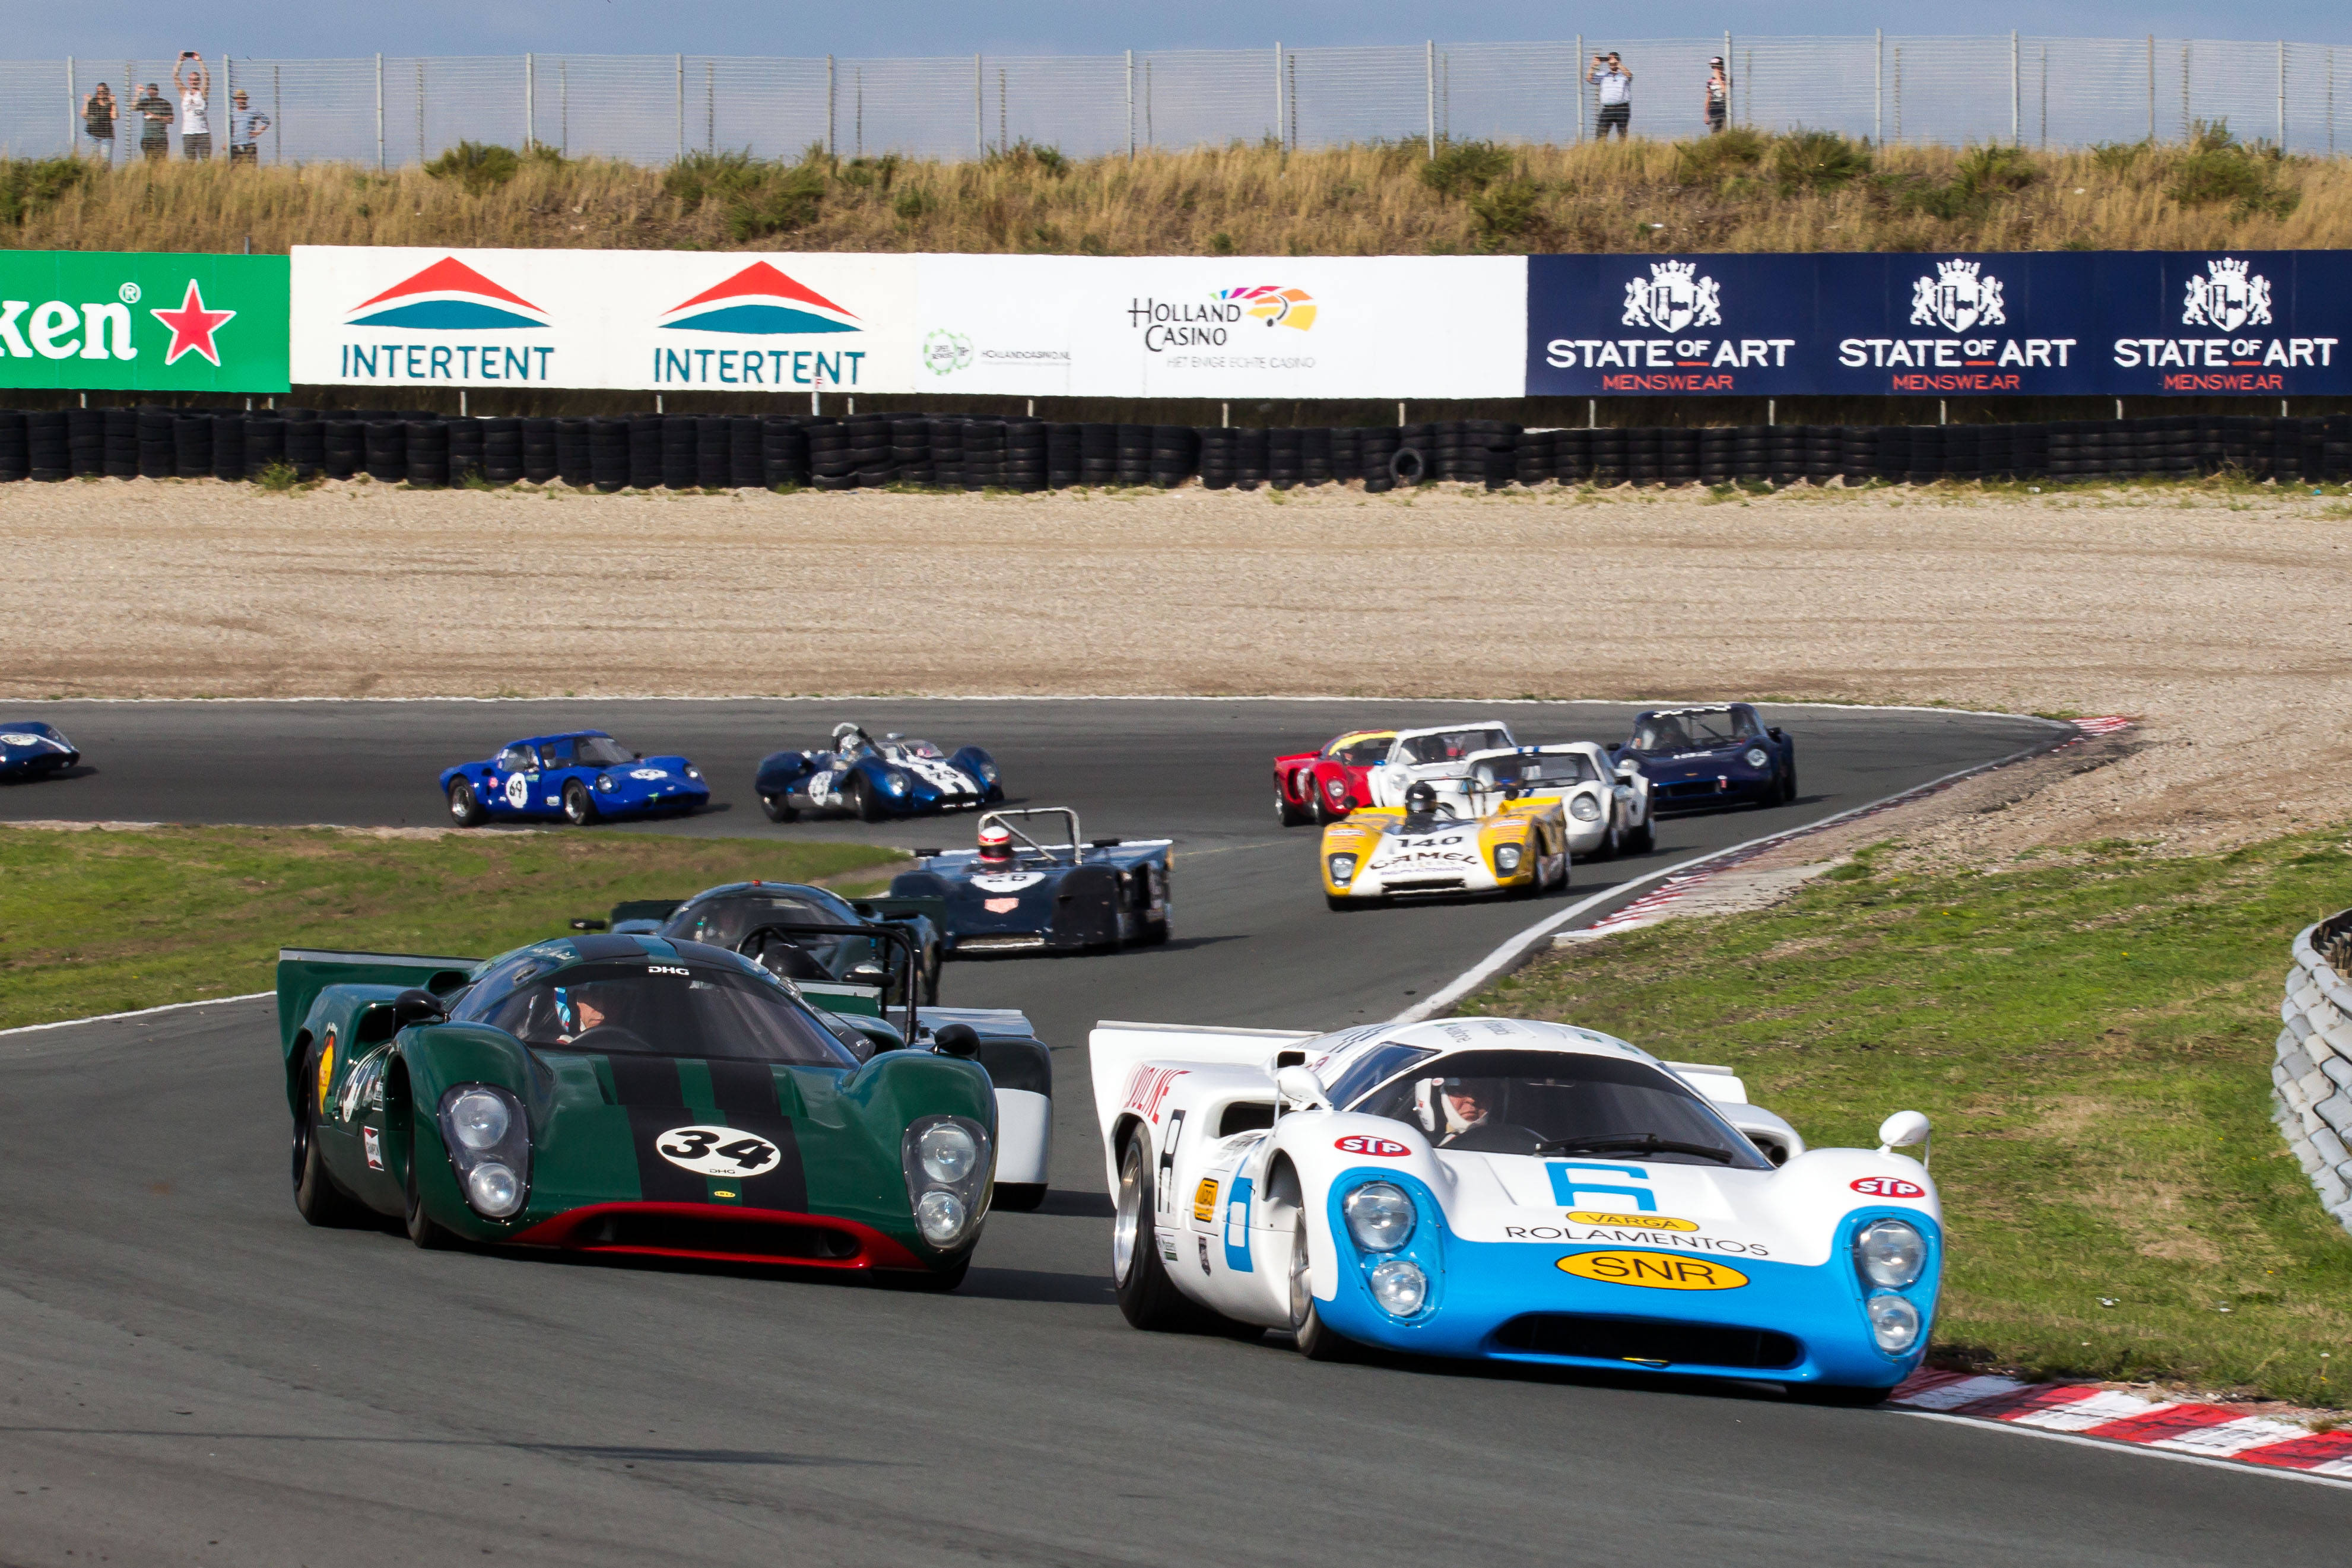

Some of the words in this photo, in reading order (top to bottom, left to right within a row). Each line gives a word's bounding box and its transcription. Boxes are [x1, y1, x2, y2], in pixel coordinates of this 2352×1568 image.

[1127, 297, 1241, 328] HOLLAND
[1145, 325, 1227, 353] CASINO
[342, 344, 555, 380] INTERTENT
[1269, 357, 1316, 369] CASINO
[1546, 339, 1674, 367] STATE
[1675, 340, 1712, 357] OF
[1712, 339, 1795, 367] ART
[1839, 338, 1962, 367] STATE
[1963, 339, 1998, 357] OF
[1998, 338, 2077, 367] ART
[2114, 338, 2230, 367] STATE
[2232, 339, 2263, 356] OF
[2262, 338, 2338, 367] ART
[654, 347, 866, 385] INTERTENT
[1603, 374, 1734, 391] MENSWEAR
[1893, 374, 2020, 390] MENSWEAR
[2164, 374, 2283, 390] MENSWEAR
[1397, 836, 1463, 848] 140
[1369, 852, 1478, 869] CAMEL
[647, 966, 690, 976] DHG
[661, 1130, 776, 1170] 34
[1342, 1136, 1403, 1153] STP
[1859, 1177, 1918, 1196] STP
[1586, 1214, 1681, 1229] VARGA
[1504, 1225, 1769, 1256] ROLAMENTOS
[1592, 1256, 1717, 1285] SNR
